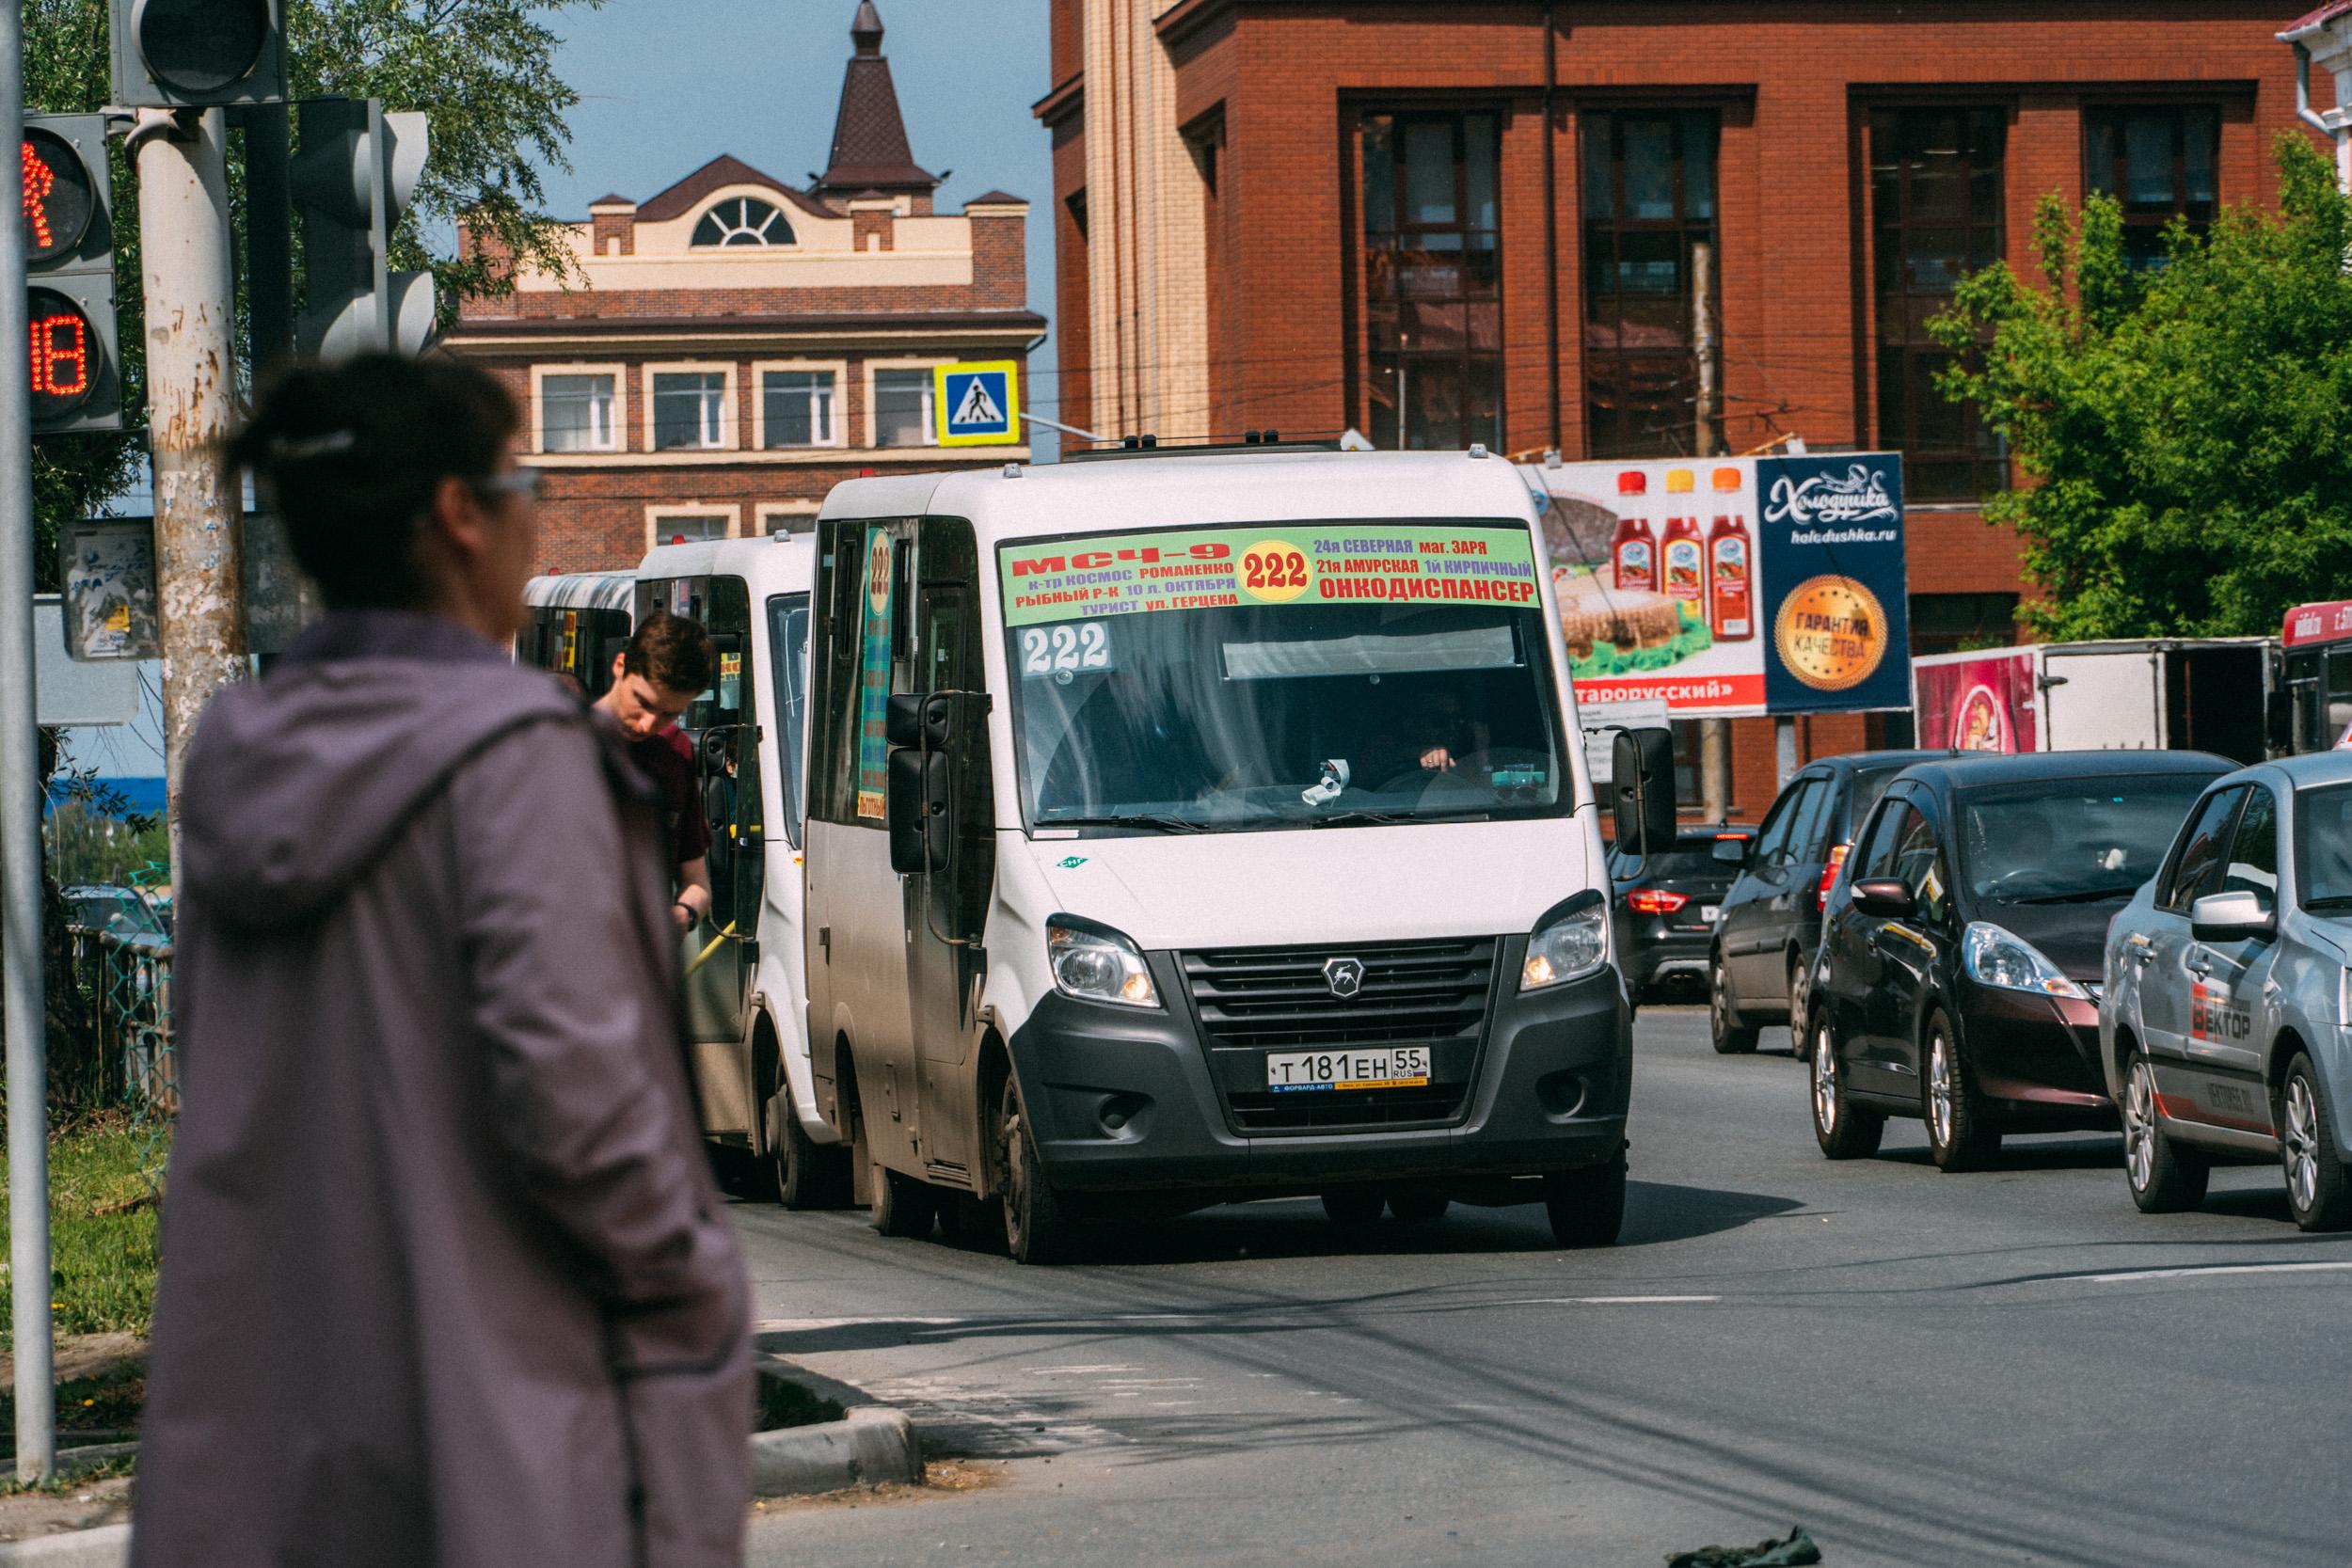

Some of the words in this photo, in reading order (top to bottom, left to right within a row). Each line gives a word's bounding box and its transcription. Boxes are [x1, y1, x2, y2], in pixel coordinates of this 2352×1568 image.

[30, 315, 87, 396] 18
[1313, 540, 1341, 554] 24я
[1343, 539, 1413, 554] СЕВЕРНАЯ
[1419, 542, 1450, 554] маг.
[1452, 540, 1488, 555] ЗАРЯ
[1791, 528, 1897, 545] holodushka.ru
[871, 546, 890, 594] 222
[1012, 543, 1231, 577] МСЧ-9
[1244, 552, 1308, 588] 222
[1316, 559, 1342, 574] 21я
[1343, 559, 1419, 574] АМУРСКАЯ
[1424, 559, 1441, 574] 1й
[1444, 560, 1533, 578] КИРПИЧНЫЙ
[1028, 578, 1062, 591] к-тр
[1065, 569, 1133, 588] КОСМОС
[1139, 562, 1234, 579] РОМАНЕНКО
[1015, 587, 1089, 608] РЫБНЫЙ
[1092, 586, 1120, 599] Р-К
[1125, 583, 1143, 596] 10
[1165, 578, 1236, 594] ОКТЯБРЯ
[1319, 578, 1534, 602] ОНКОДИСПАНСЕР
[1081, 600, 1138, 616] ТУРИСТ
[1145, 599, 1169, 611] ул.
[1172, 594, 1239, 609] ГЕРЦЕНА
[1796, 612, 1868, 636] ГАРАНТИЯ
[1024, 622, 1108, 673] 222
[1795, 635, 1865, 657] КАЧЕСТВА
[1395, 1050, 1421, 1069] 55
[1393, 1069, 1412, 1078] RUS
